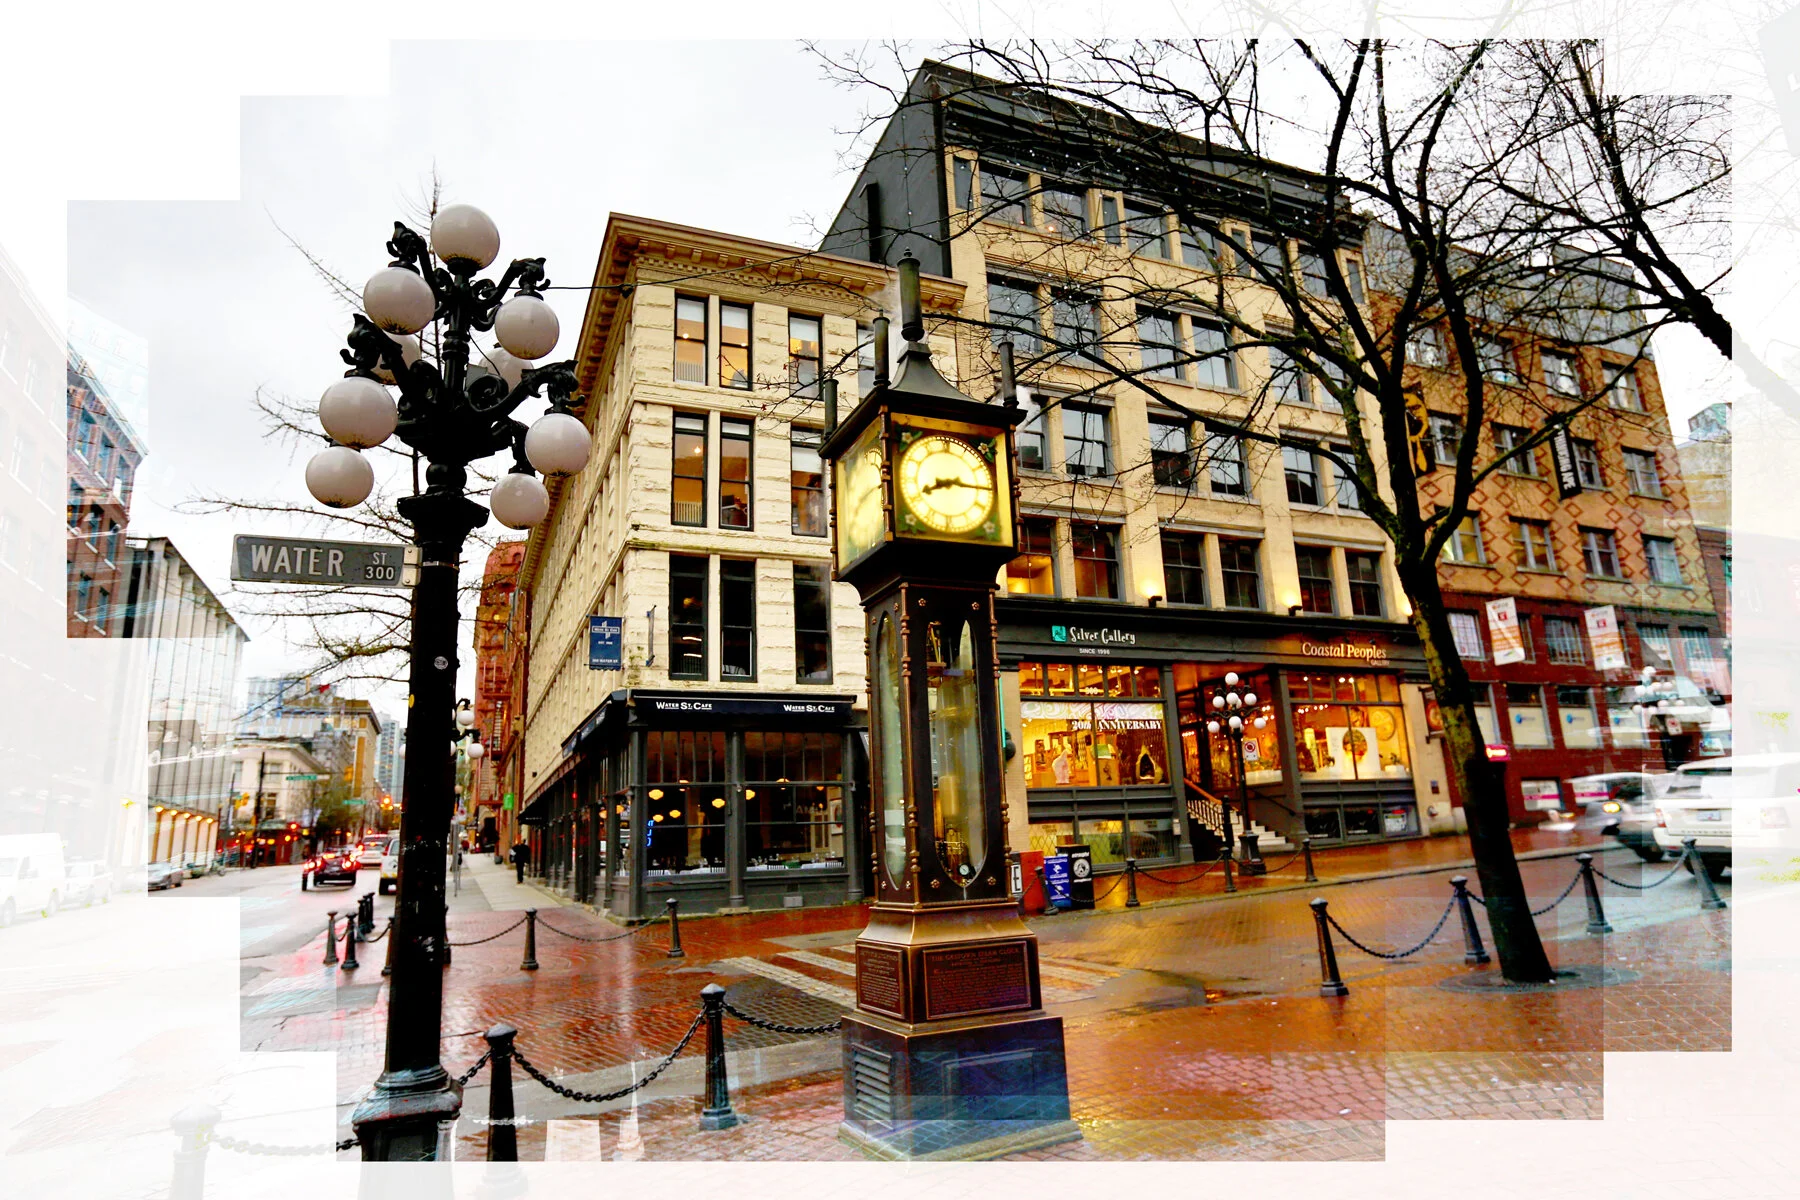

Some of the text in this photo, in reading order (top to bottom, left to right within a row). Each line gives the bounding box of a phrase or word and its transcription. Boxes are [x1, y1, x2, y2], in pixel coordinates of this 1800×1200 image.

[251, 544, 388, 577] WATER ST
[365, 566, 395, 580] 300
[1070, 626, 1136, 644] Silver Gallery
[1302, 642, 1387, 662] Coastal Peoples
[1097, 719, 1162, 730] ANNIVERSARY
